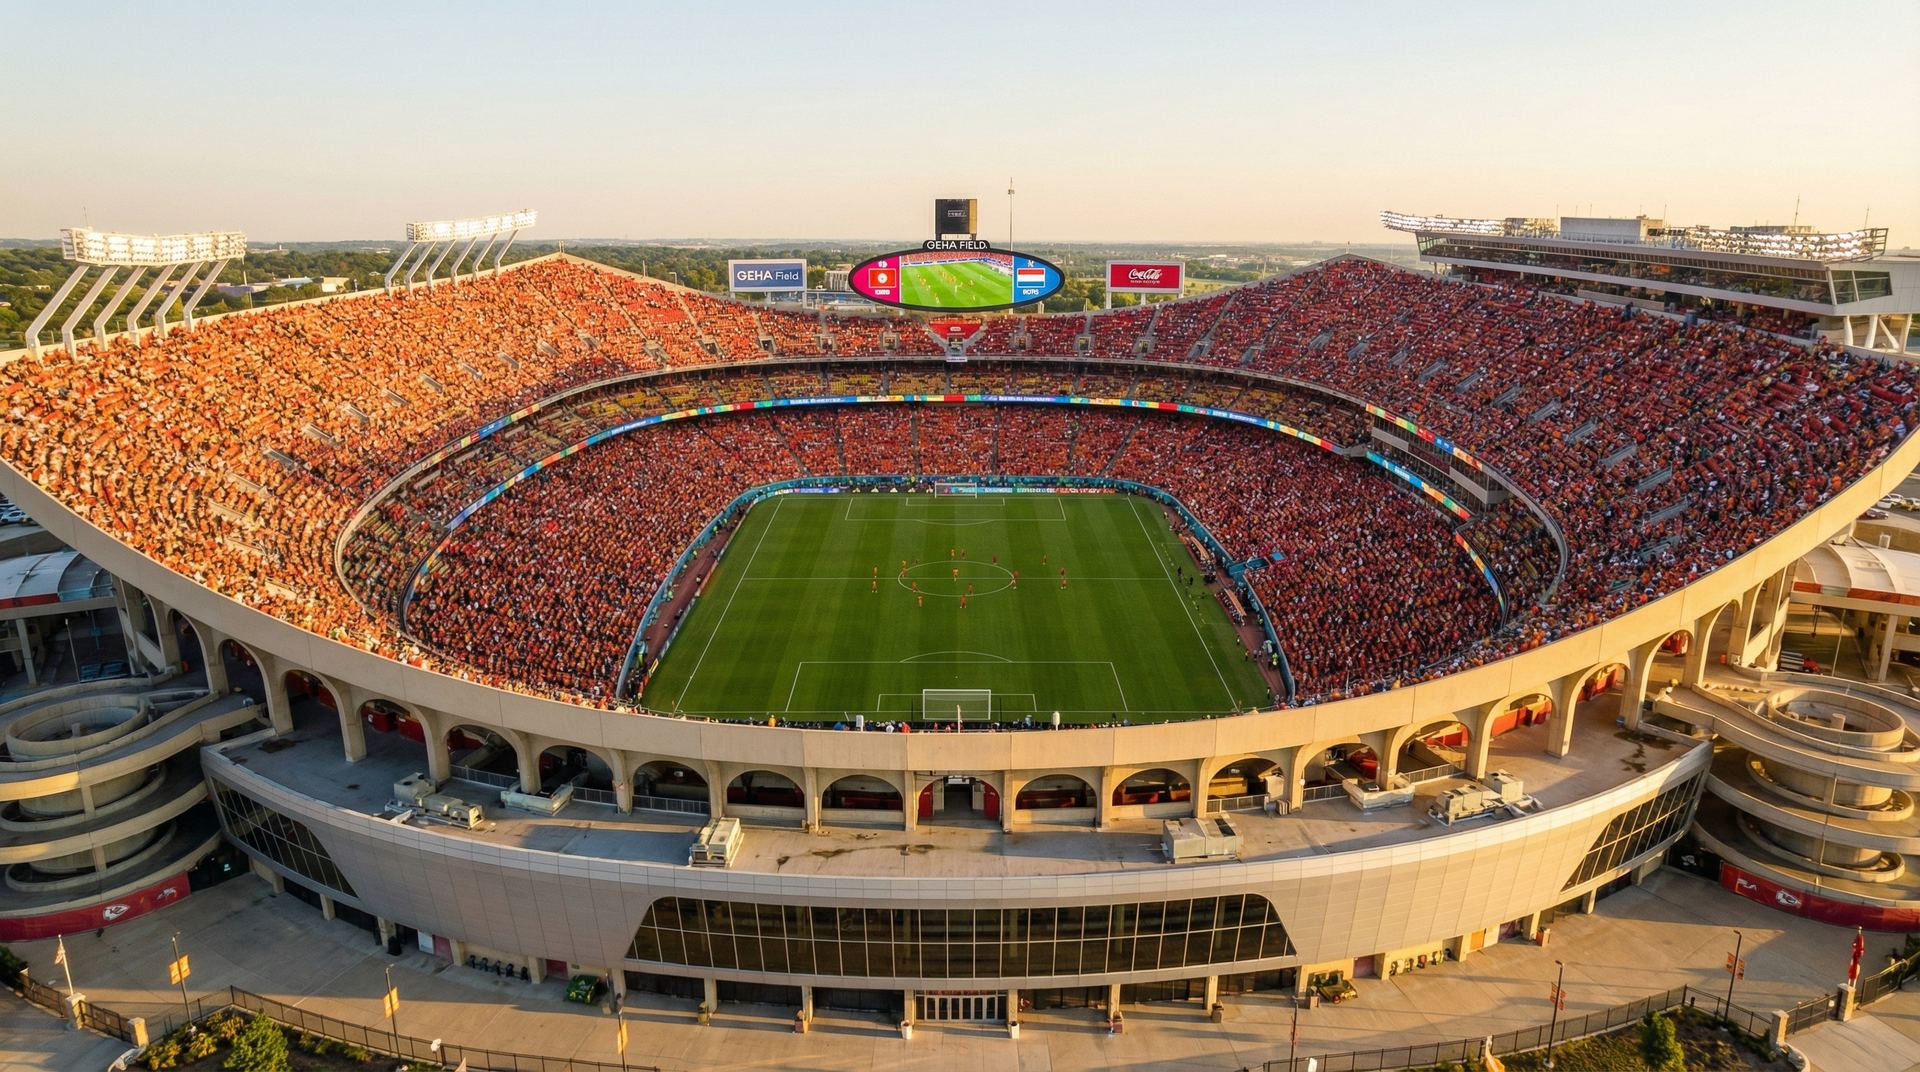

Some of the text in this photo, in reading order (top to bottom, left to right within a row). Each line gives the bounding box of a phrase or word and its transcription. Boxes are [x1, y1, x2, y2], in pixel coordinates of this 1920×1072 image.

[926, 240, 958, 250] GEHA
[736, 270, 799, 281] GEHA Field
